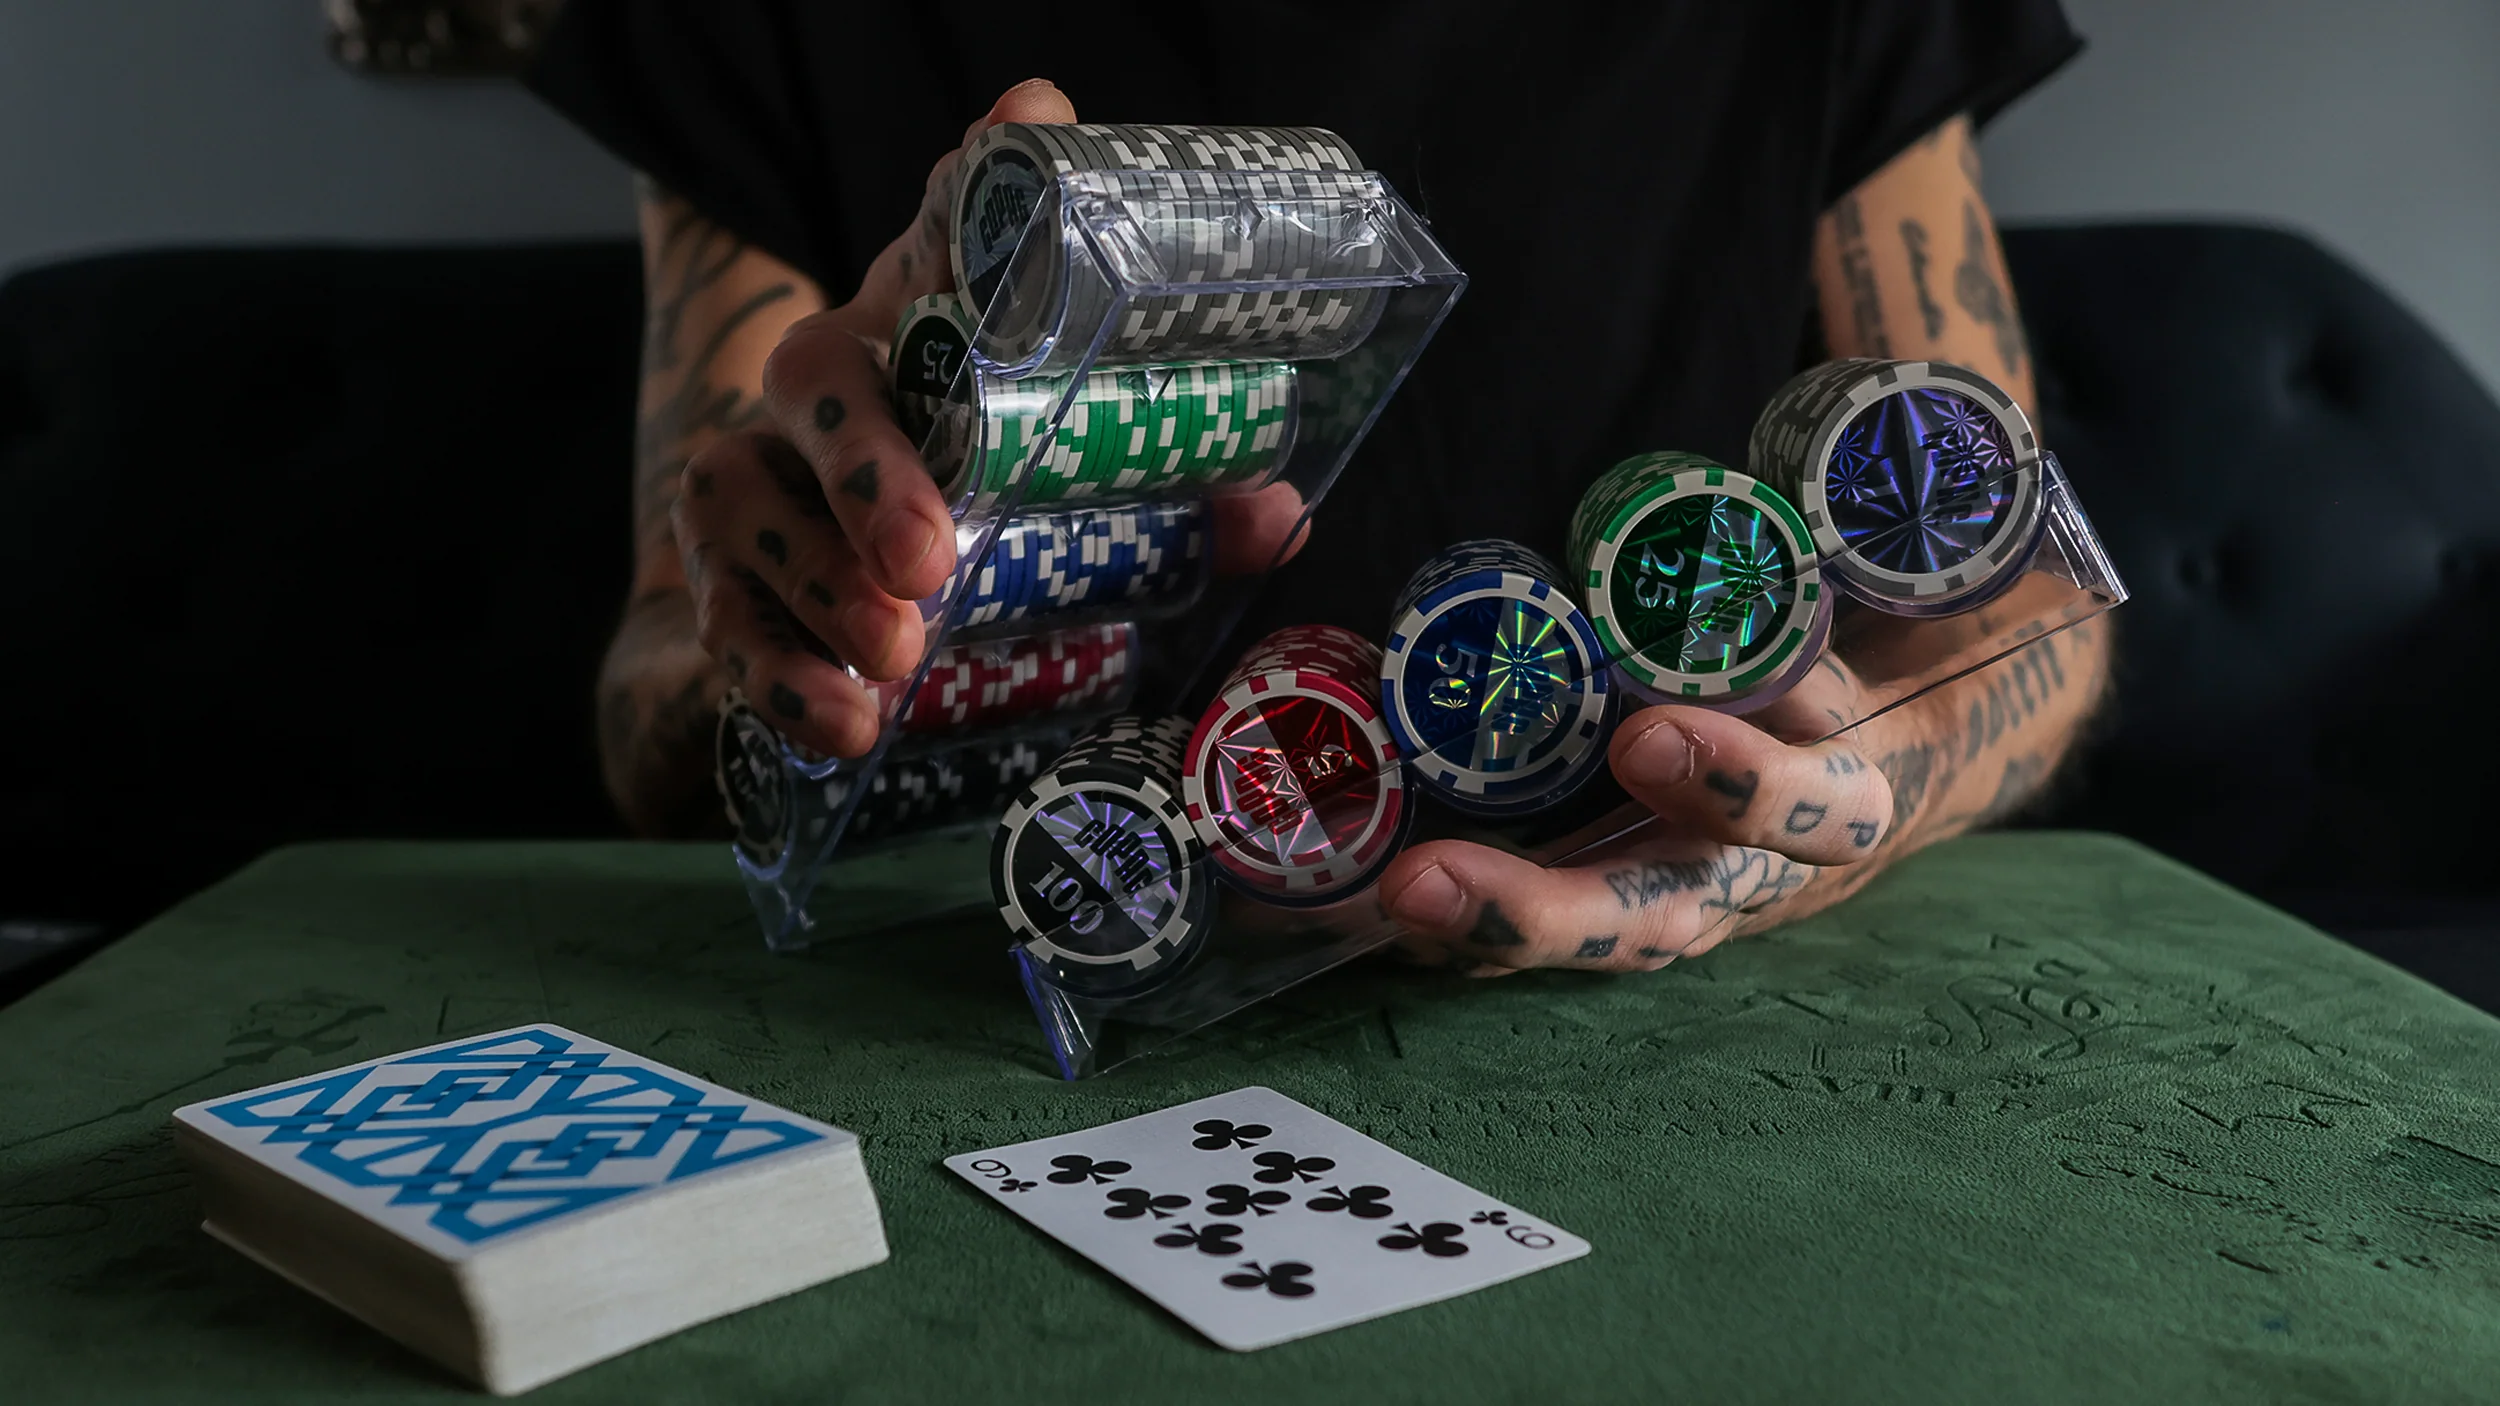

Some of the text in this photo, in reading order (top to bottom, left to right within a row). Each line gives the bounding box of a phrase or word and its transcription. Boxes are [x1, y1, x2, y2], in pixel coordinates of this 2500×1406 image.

[922, 340, 954, 385] 25
[1634, 543, 1686, 610] 25
[1428, 643, 1479, 709] 50
[1234, 748, 1304, 835] COPAG
[1073, 819, 1153, 897] COPAG
[1029, 860, 1104, 935] 100
[971, 1159, 1011, 1178] 9
[1506, 1226, 1554, 1249] 9
